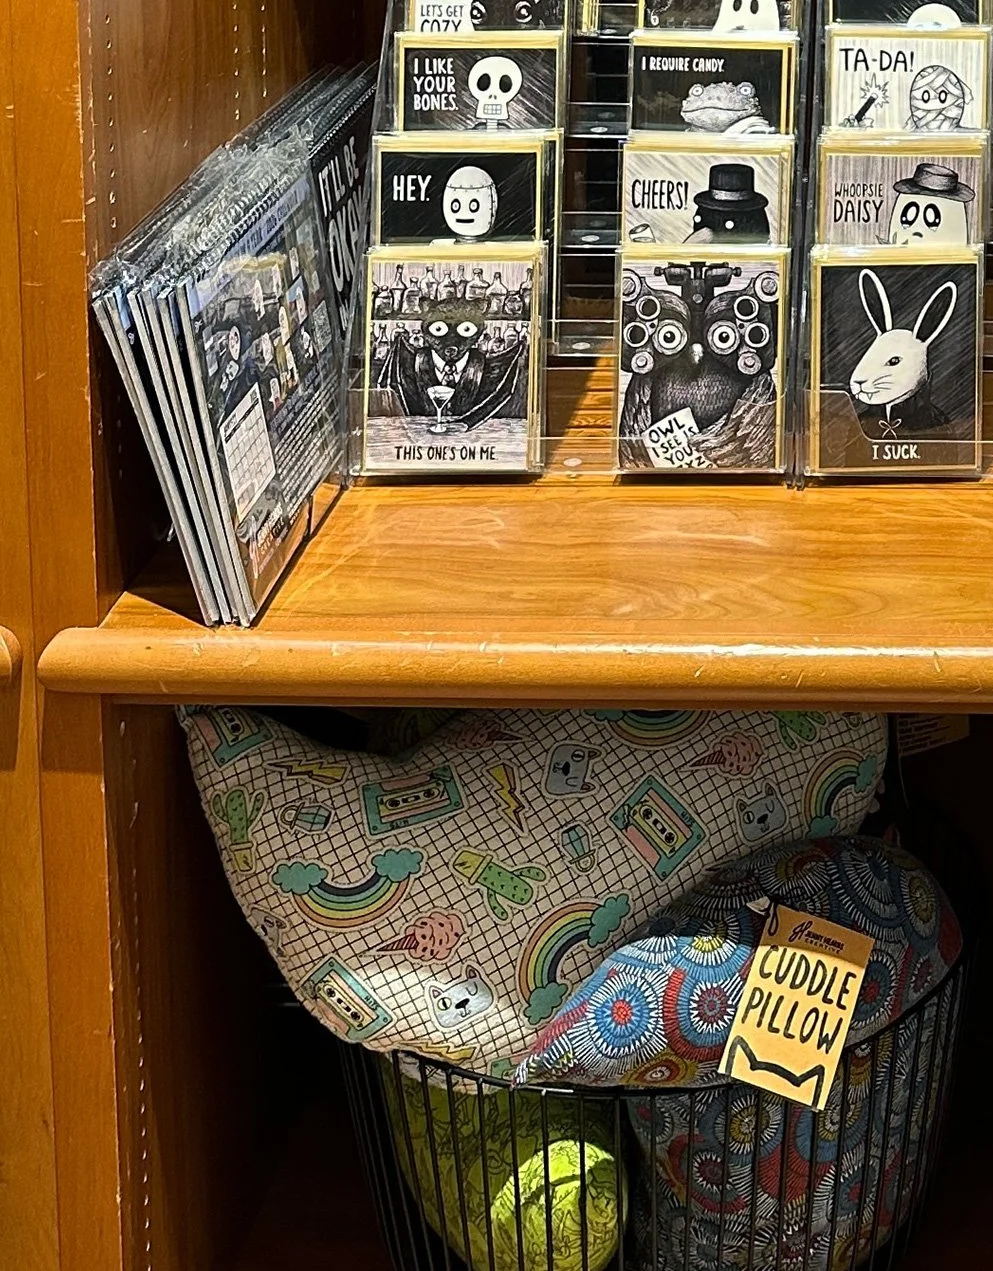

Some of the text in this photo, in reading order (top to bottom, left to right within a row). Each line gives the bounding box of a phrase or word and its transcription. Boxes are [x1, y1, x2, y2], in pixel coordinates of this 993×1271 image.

[420, 4, 464, 17] LET'S GET
[413, 58, 454, 74] I LIKE
[650, 56, 725, 72] REQUIRE CANDY.
[839, 48, 914, 72] TA-DA!
[413, 76, 456, 93] YOUR
[413, 94, 458, 111] BONES.
[393, 175, 432, 202] HEY.
[631, 179, 689, 210] CHEERS!
[835, 183, 883, 197] WHOOPSIE
[834, 200, 884, 223] DAISY
[649, 417, 685, 443] OWL
[395, 446, 496, 461] THIS ONE'S ON ME
[660, 435, 682, 454] SEE
[872, 444, 921, 460] I SUCK.
[664, 444, 693, 465] YOU
[759, 945, 857, 1010] CUDDLE
[741, 986, 843, 1054] PILLOW
